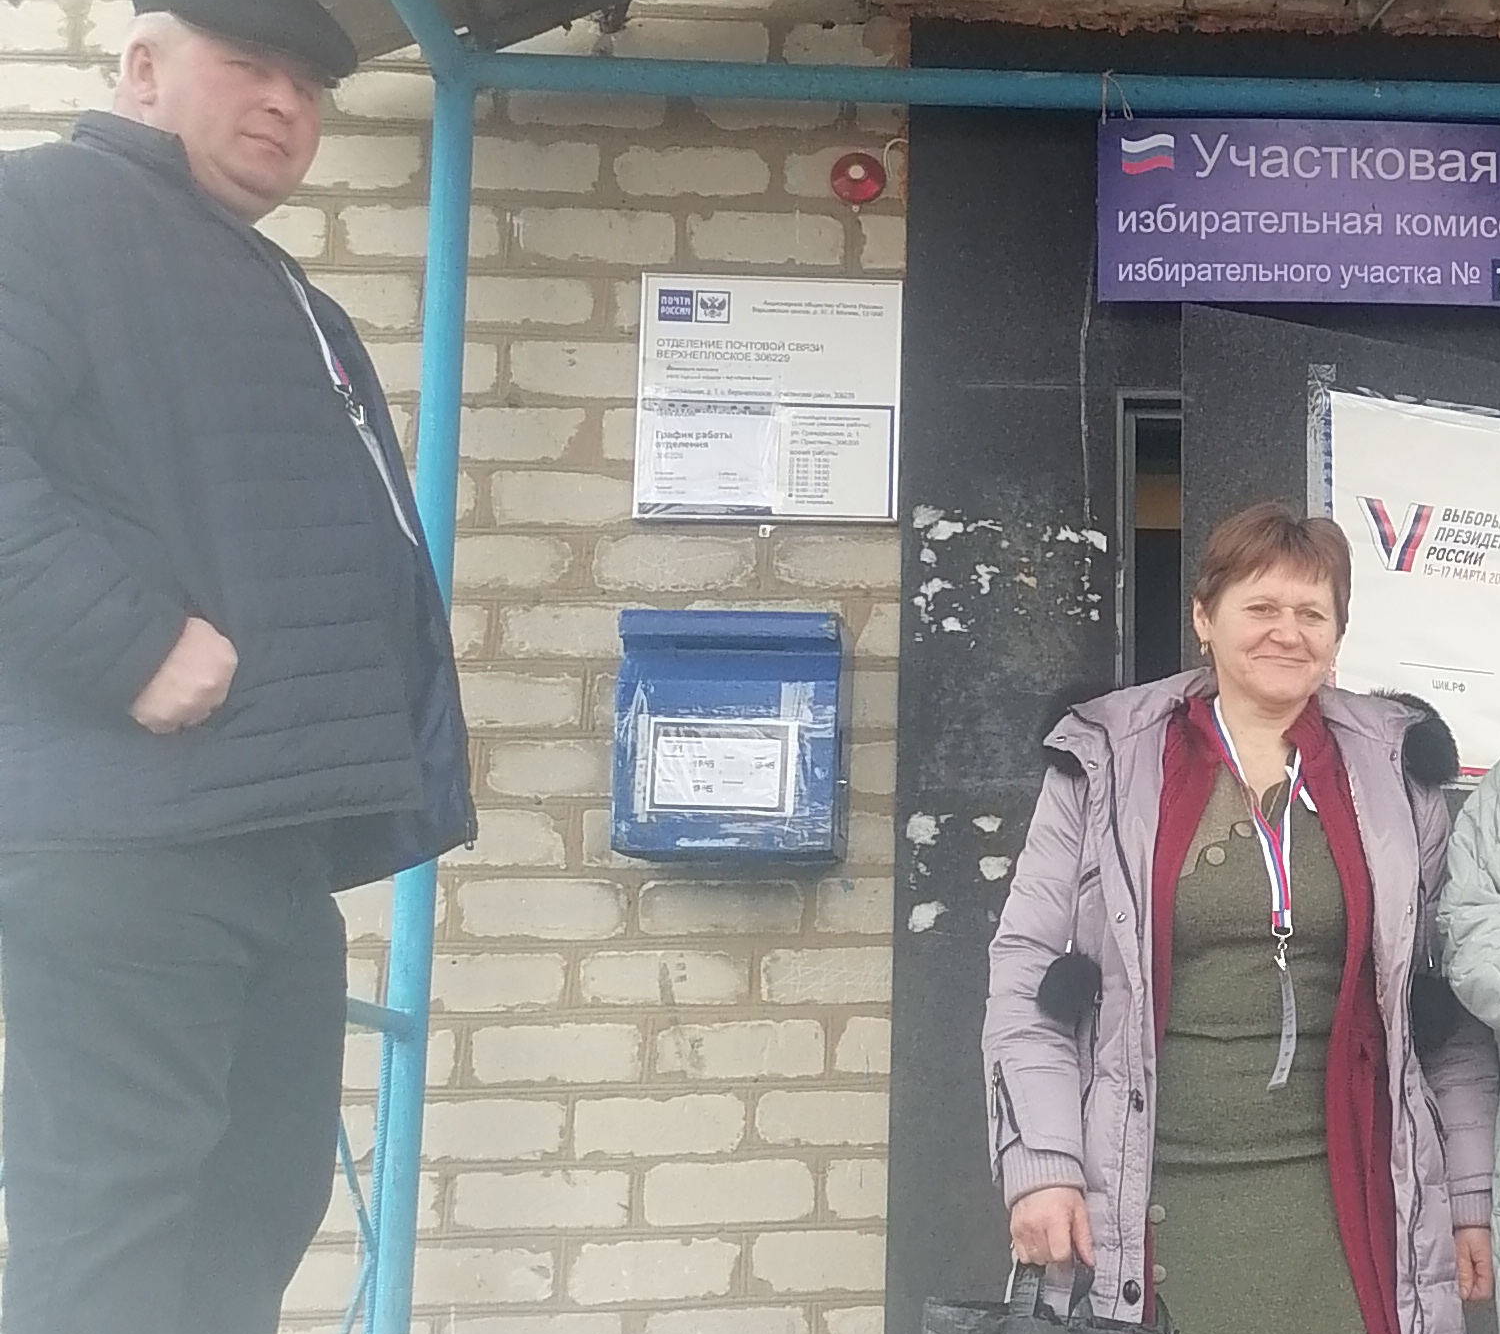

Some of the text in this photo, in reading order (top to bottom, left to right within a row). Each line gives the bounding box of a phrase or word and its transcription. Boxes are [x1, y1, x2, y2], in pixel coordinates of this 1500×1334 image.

[1190, 133, 1498, 184] Участковая
[1117, 204, 1382, 239] избирательная
[1117, 257, 1331, 288] избирательного
[1340, 264, 1442, 288] участка
[1450, 260, 1481, 285] №
[660, 306, 691, 316] РОССИИ
[656, 338, 824, 353] ОТДЕЛЕНИЕ ПОЧТОВОЙ СВЯЗИ
[656, 349, 751, 361] ВЕРХНЕПЛОСКОЕ
[1426, 546, 1486, 567] РОССИИ
[1452, 567, 1487, 583] МАРТА
[1431, 679, 1466, 693] ЦИК.РФ
